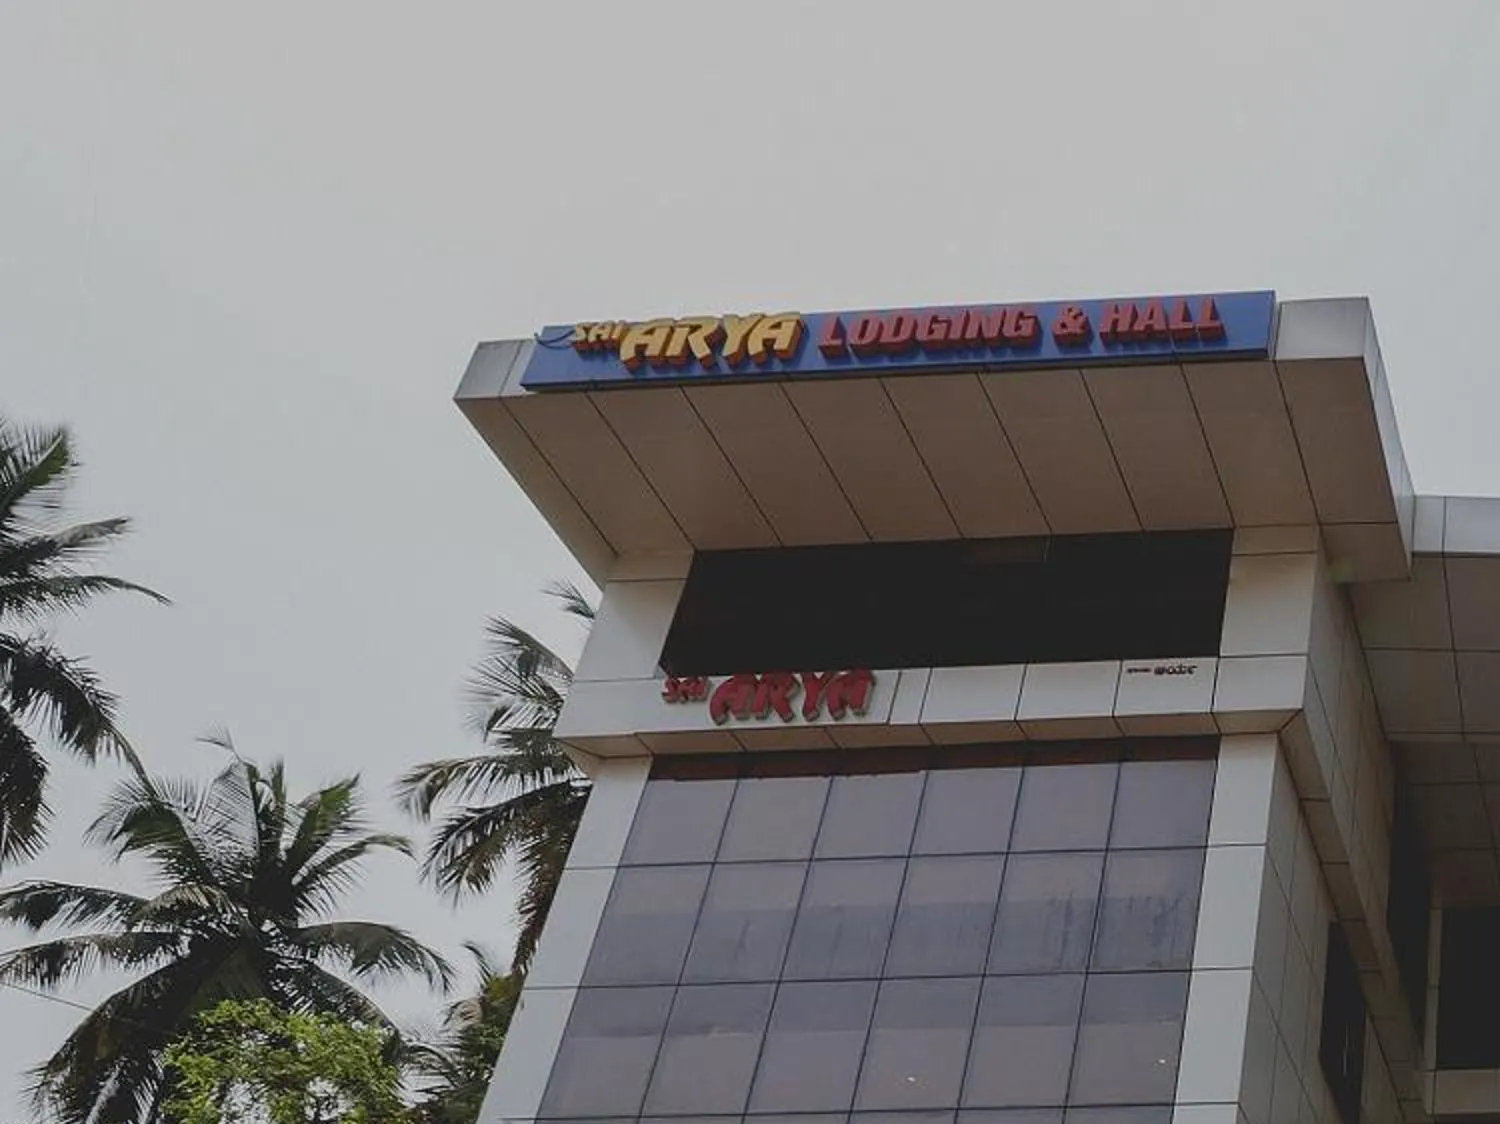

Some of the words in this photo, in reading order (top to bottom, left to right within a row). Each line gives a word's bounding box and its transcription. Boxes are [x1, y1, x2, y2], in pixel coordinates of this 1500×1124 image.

[571, 320, 626, 349] SAI
[619, 312, 808, 370] ARYA
[818, 304, 1042, 354] LODGING
[1051, 304, 1090, 346] &
[1098, 297, 1225, 342] HALL
[709, 668, 876, 725] ARYA
